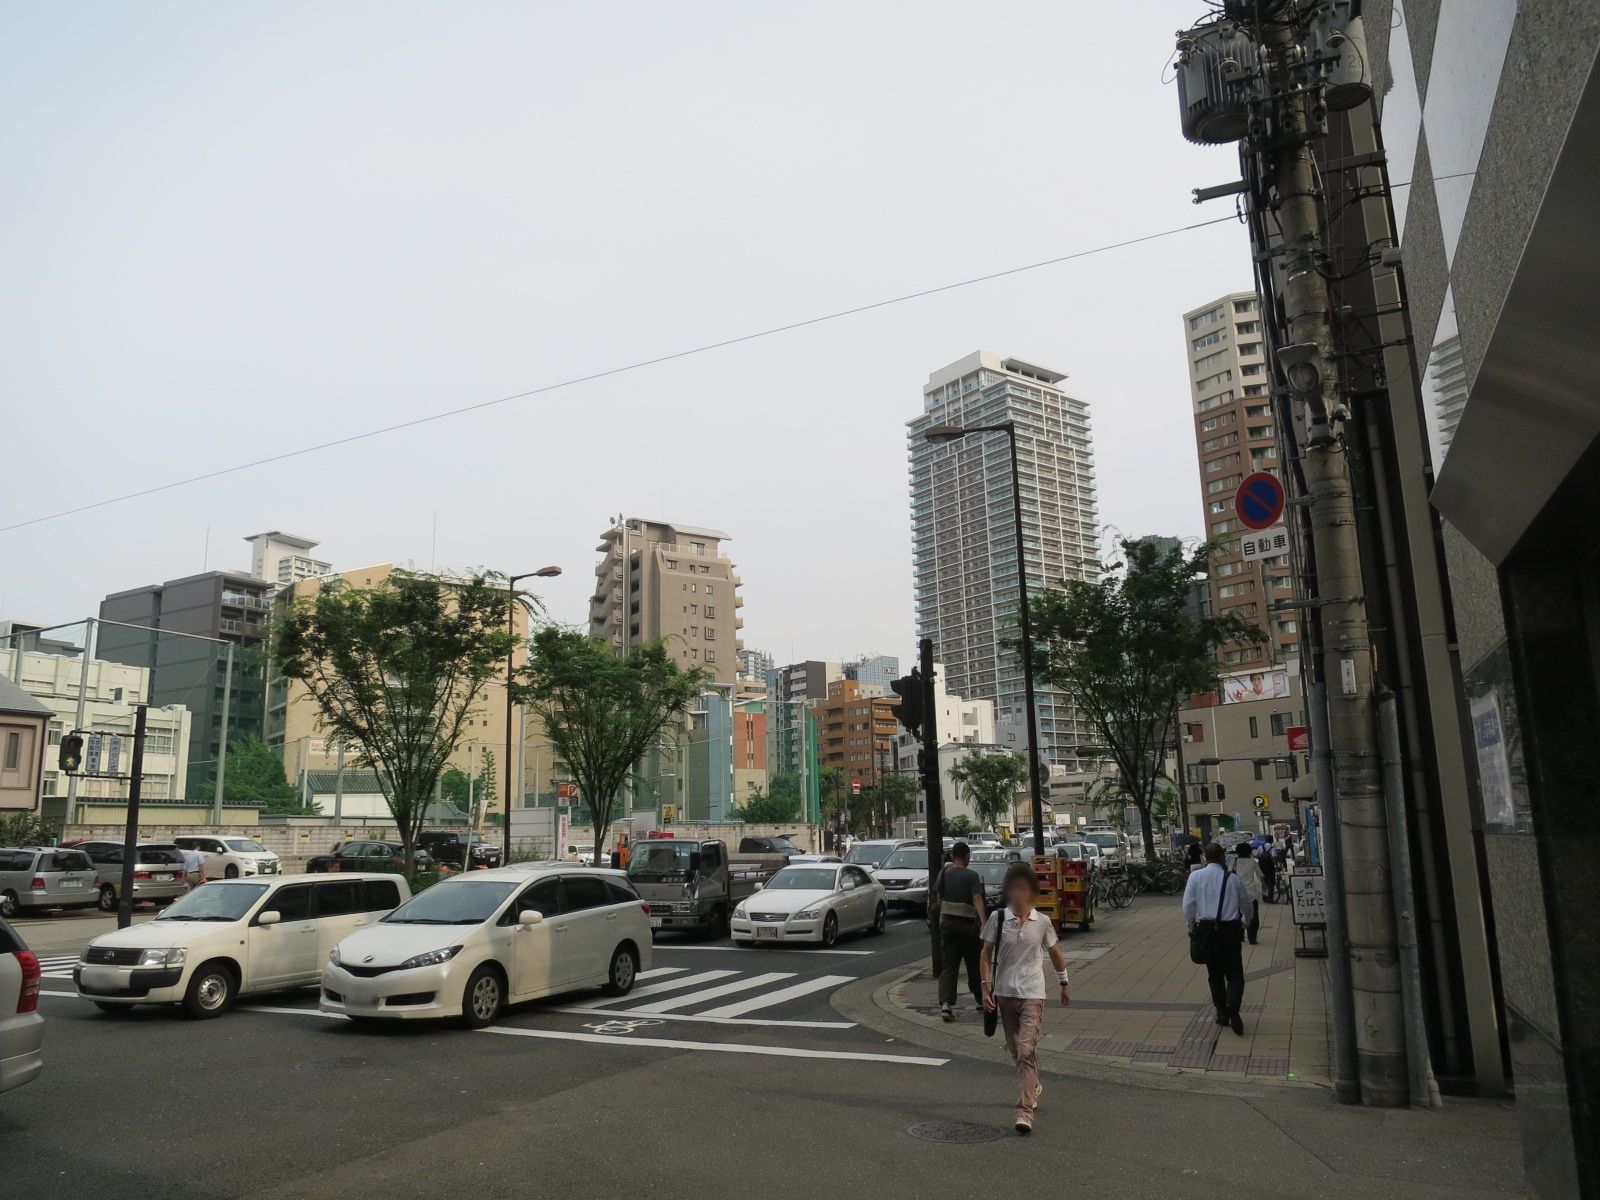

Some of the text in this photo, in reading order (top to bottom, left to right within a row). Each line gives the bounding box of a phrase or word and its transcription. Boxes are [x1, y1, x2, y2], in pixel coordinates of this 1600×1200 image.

[1243, 534, 1286, 556] 自動車
[1256, 798, 1263, 807] P
[1304, 880, 1313, 889] 酒
[1296, 889, 1322, 898] ビール
[1297, 898, 1325, 907] たばこ
